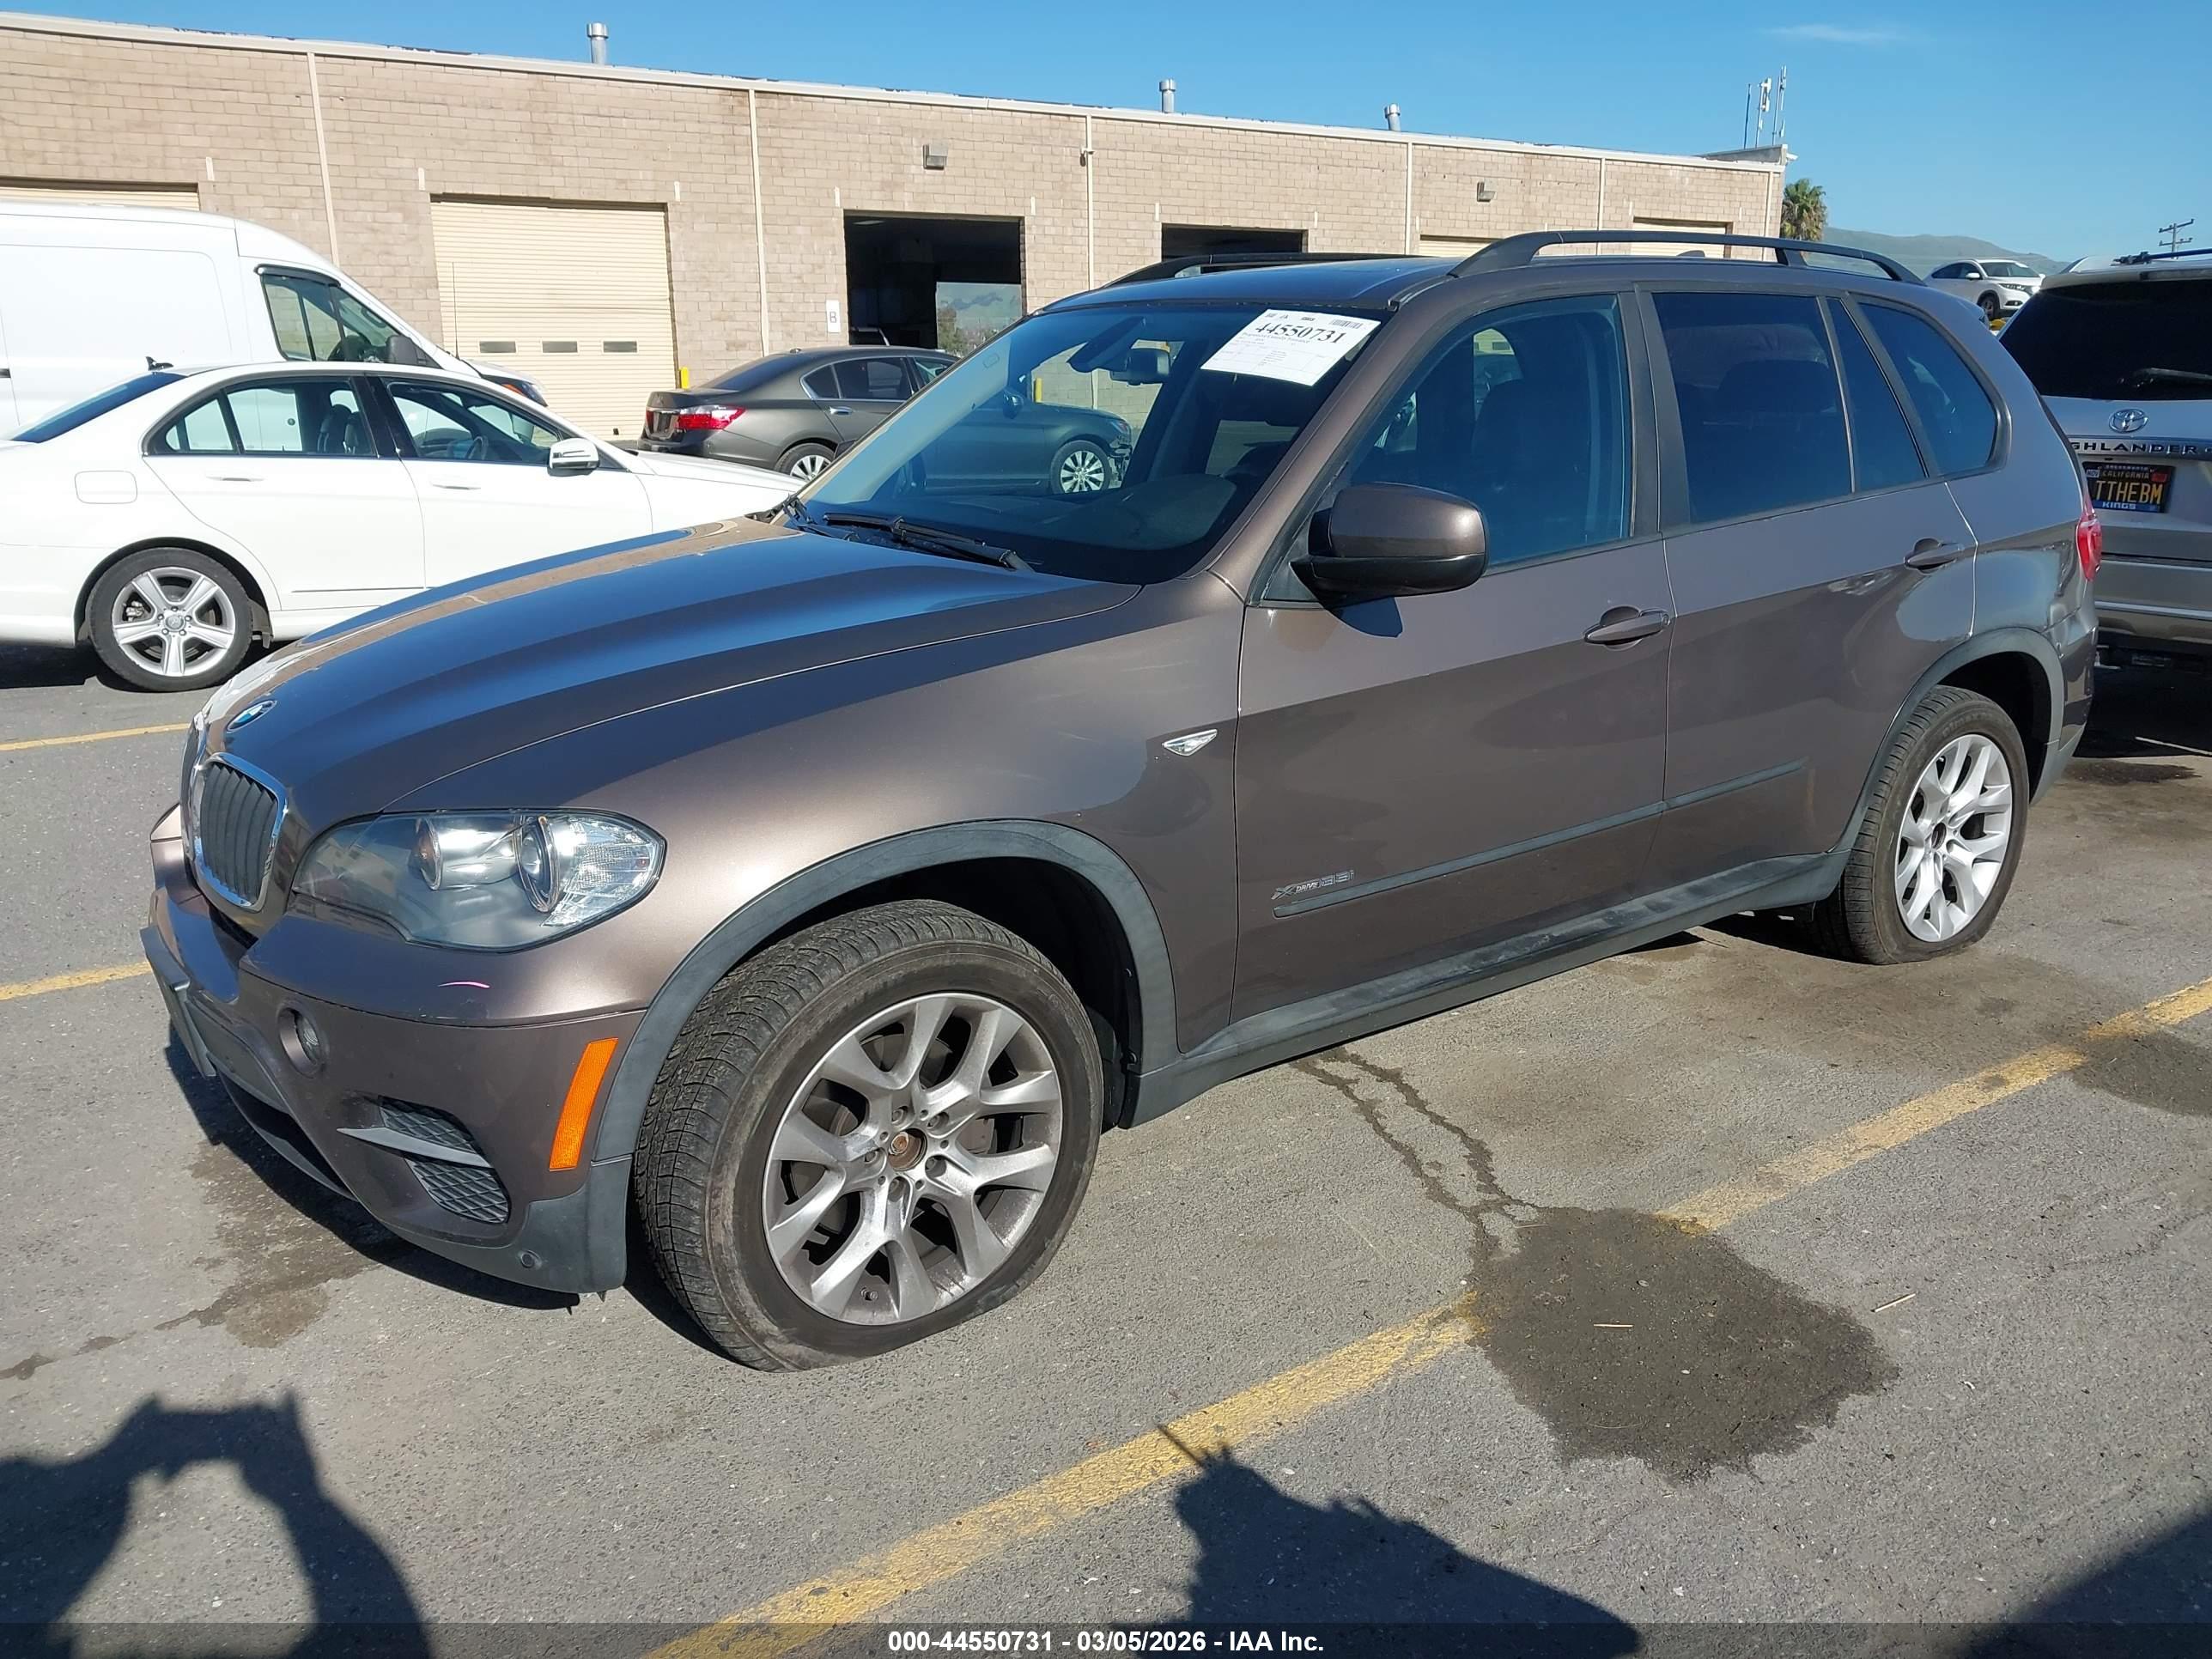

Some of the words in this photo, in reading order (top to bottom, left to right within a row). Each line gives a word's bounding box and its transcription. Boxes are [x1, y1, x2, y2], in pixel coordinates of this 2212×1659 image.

[829, 311, 837, 324] B
[1255, 322, 1347, 343] 44550731
[2102, 470, 2149, 479] CALIFORNIA
[2101, 501, 2136, 510] KINGS
